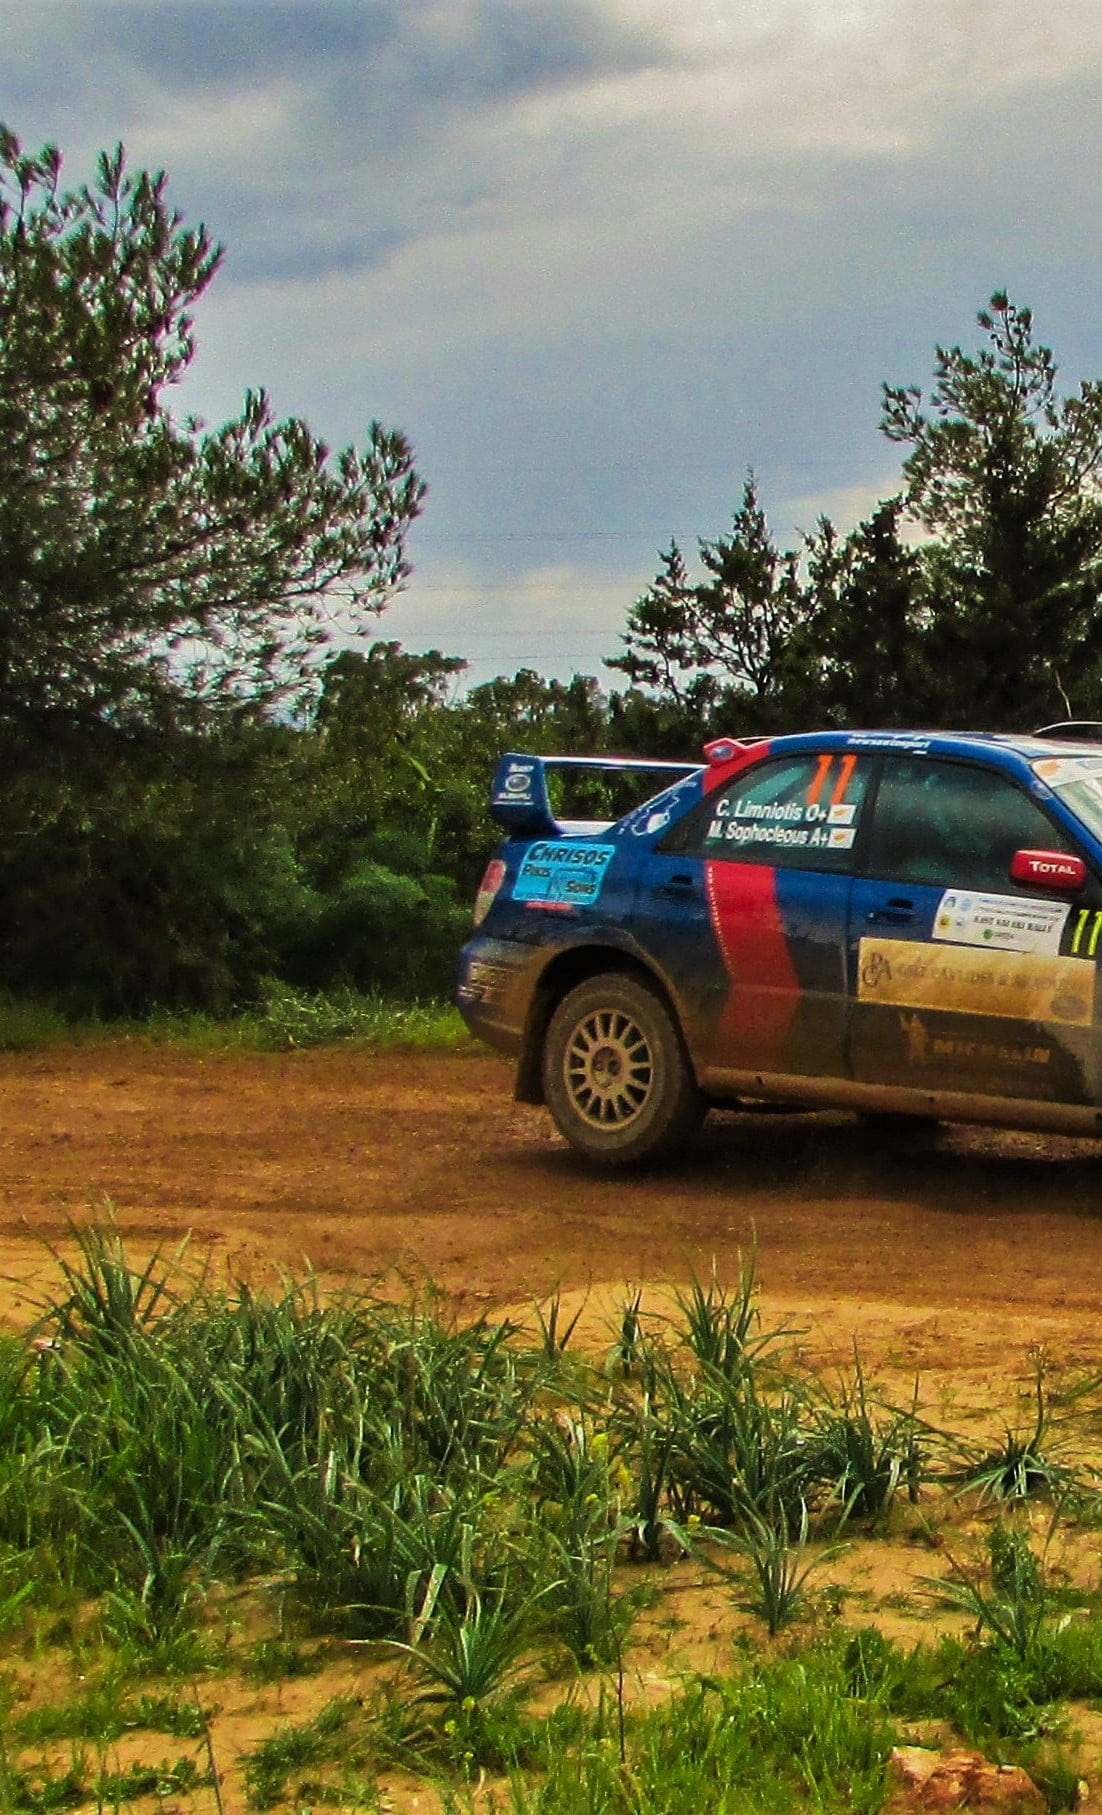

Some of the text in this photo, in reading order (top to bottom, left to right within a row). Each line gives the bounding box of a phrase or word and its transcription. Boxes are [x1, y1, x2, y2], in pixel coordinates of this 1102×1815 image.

[806, 754, 858, 804] 11
[716, 800, 826, 822] C. Limniotis O+
[706, 821, 829, 845] M. Sophocleous A+
[1029, 861, 1077, 875] TOTAL
